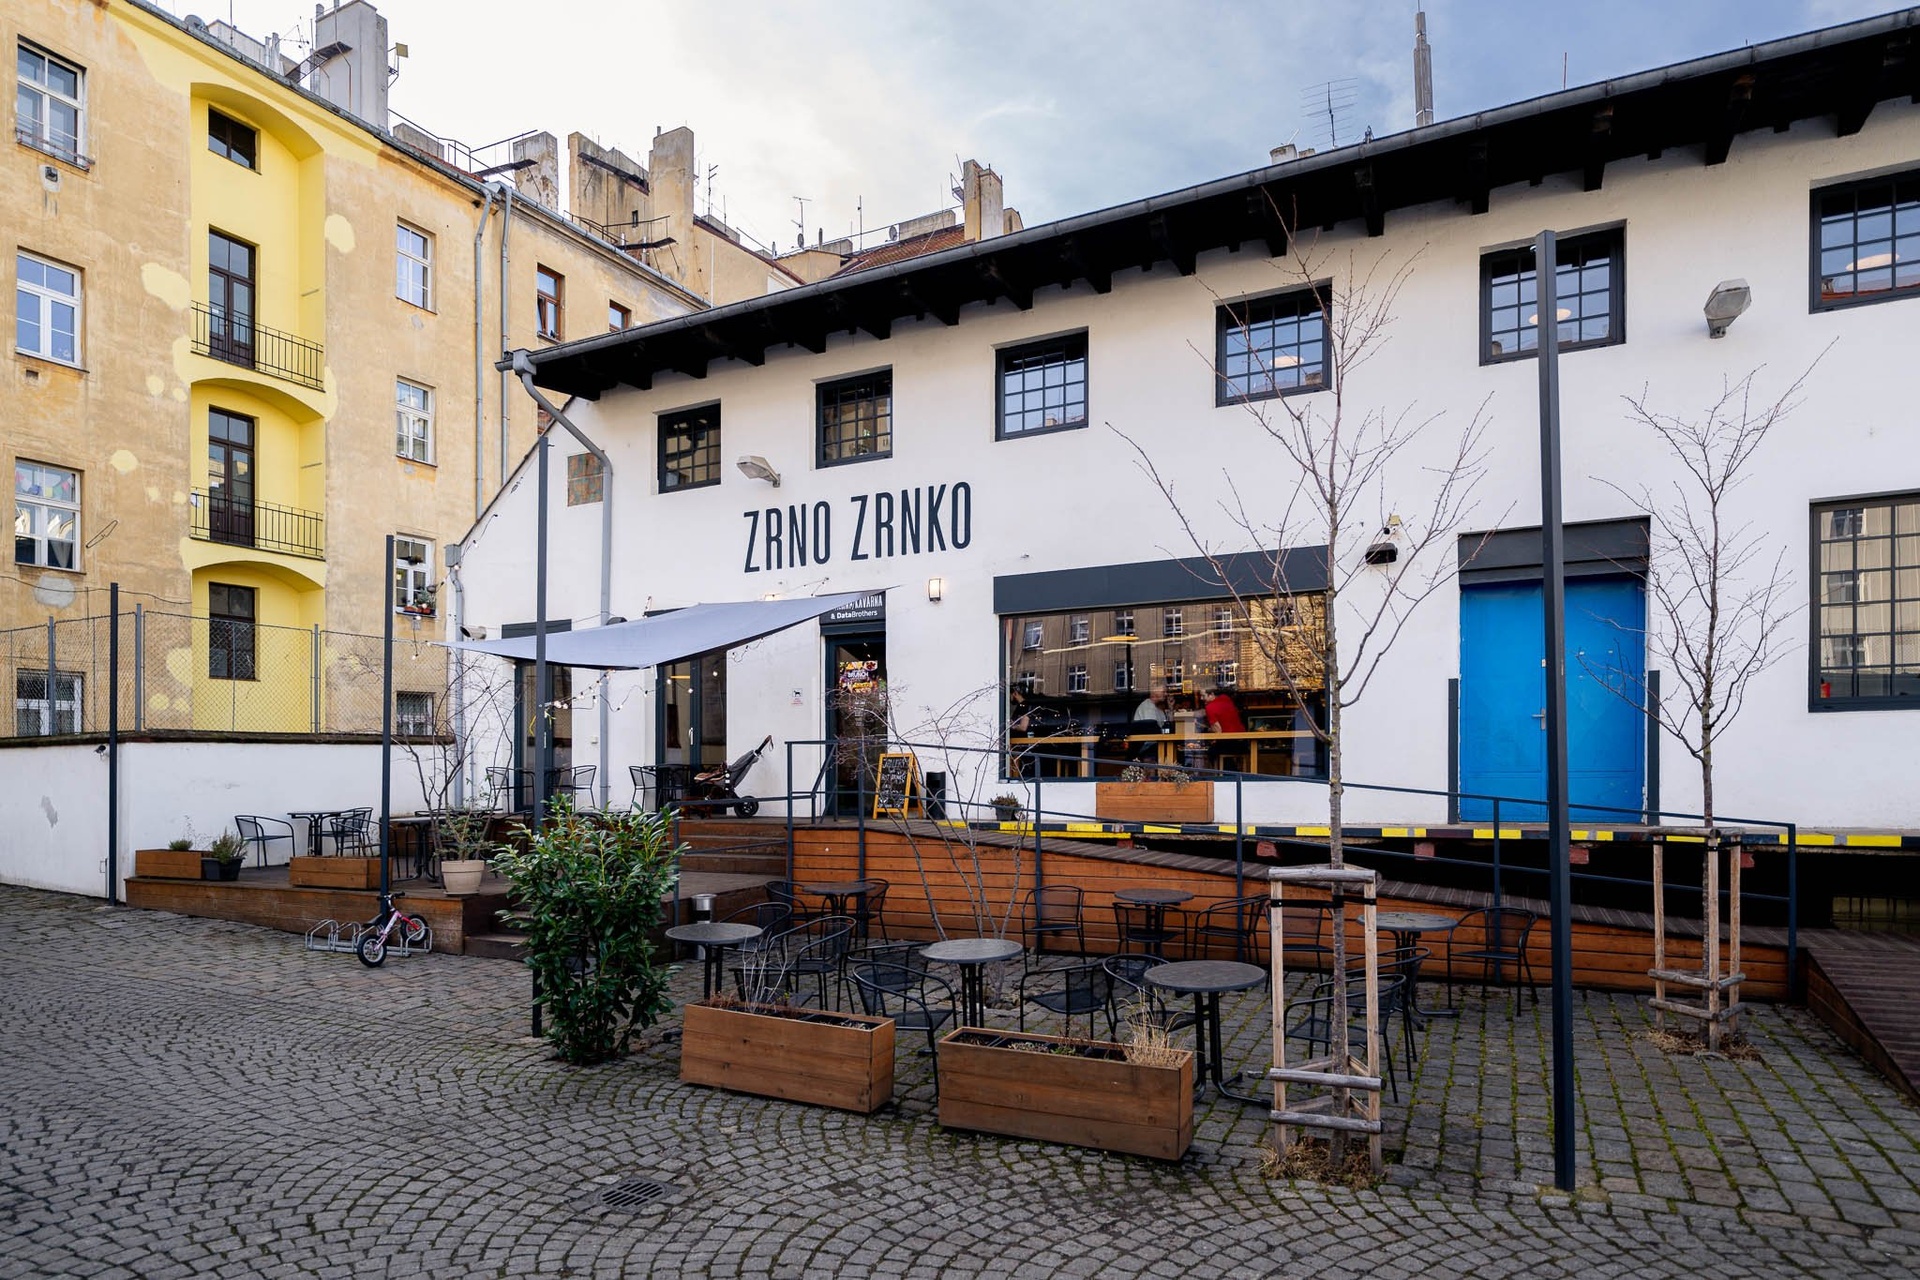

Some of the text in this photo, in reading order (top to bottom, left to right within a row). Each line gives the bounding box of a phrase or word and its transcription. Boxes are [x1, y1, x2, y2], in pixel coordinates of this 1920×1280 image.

[743, 481, 971, 574] ZRNO ZRNKO
[836, 610, 878, 619] DataBrothers
